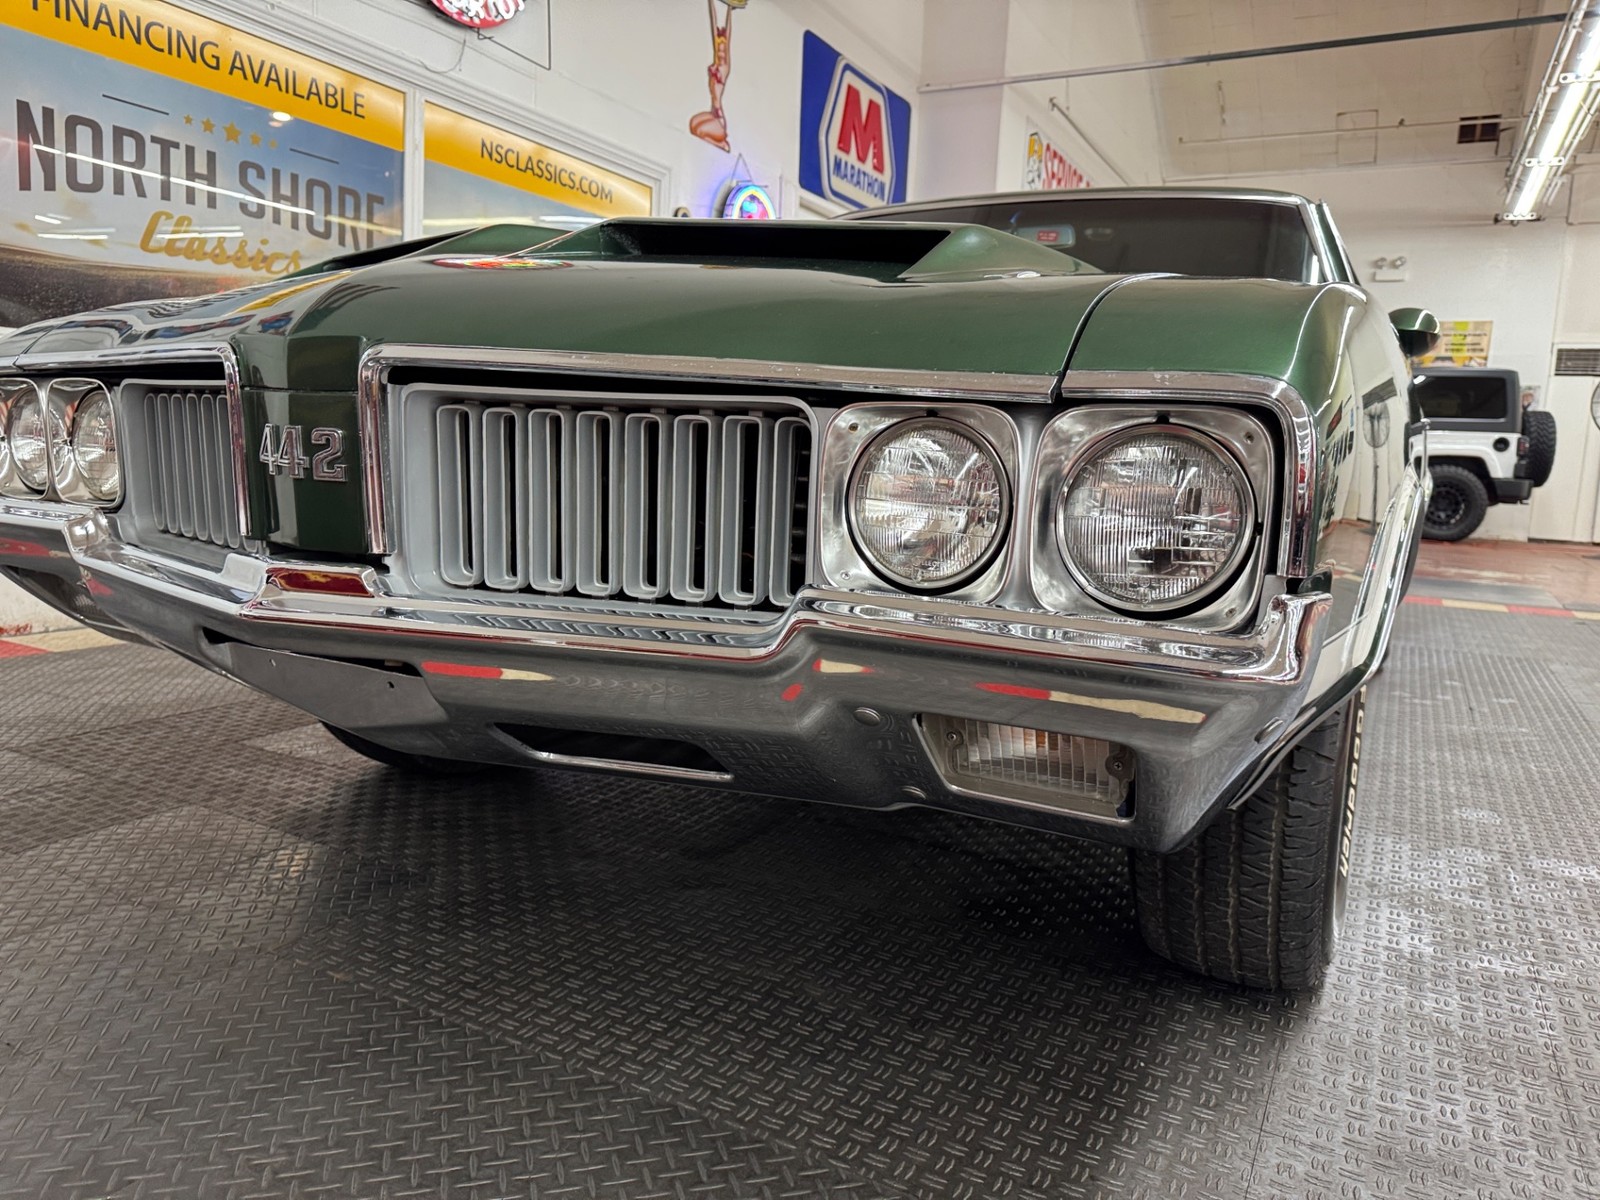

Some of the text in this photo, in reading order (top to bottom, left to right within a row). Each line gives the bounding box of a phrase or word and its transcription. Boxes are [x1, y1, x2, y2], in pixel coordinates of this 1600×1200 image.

[229, 50, 366, 119] AVAILABLE
[17, 99, 217, 210] NORTH
[837, 83, 884, 175] M
[480, 138, 613, 203] NSCLASSICS.COM
[833, 154, 885, 202] MARATHON
[140, 210, 301, 275] Classics
[260, 423, 347, 481] 442
